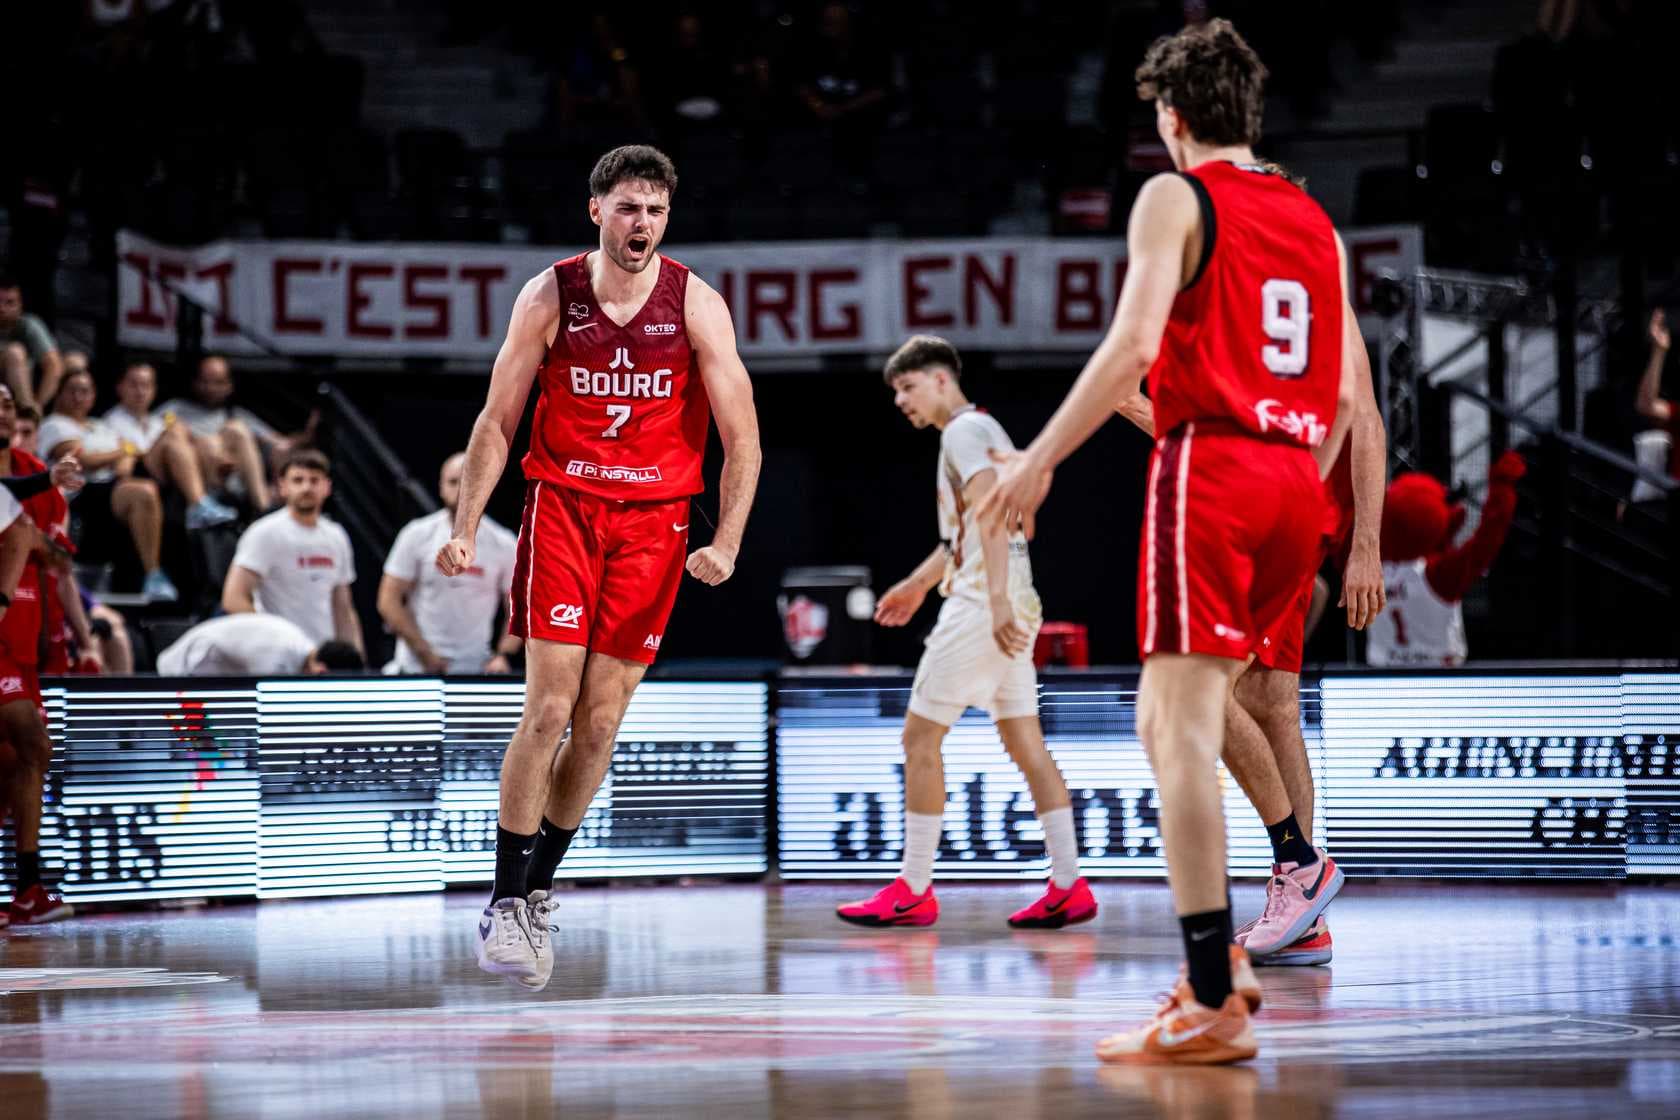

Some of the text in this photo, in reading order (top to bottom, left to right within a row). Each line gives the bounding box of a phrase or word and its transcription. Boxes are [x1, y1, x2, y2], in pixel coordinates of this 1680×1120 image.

[272, 259, 506, 338] C'EST
[904, 252, 1017, 328] EN
[644, 323, 676, 333] OKTEO
[1261, 278, 1310, 379] 9
[570, 366, 673, 398] BOURG
[601, 404, 632, 438] 7
[1390, 607, 1409, 646] 1
